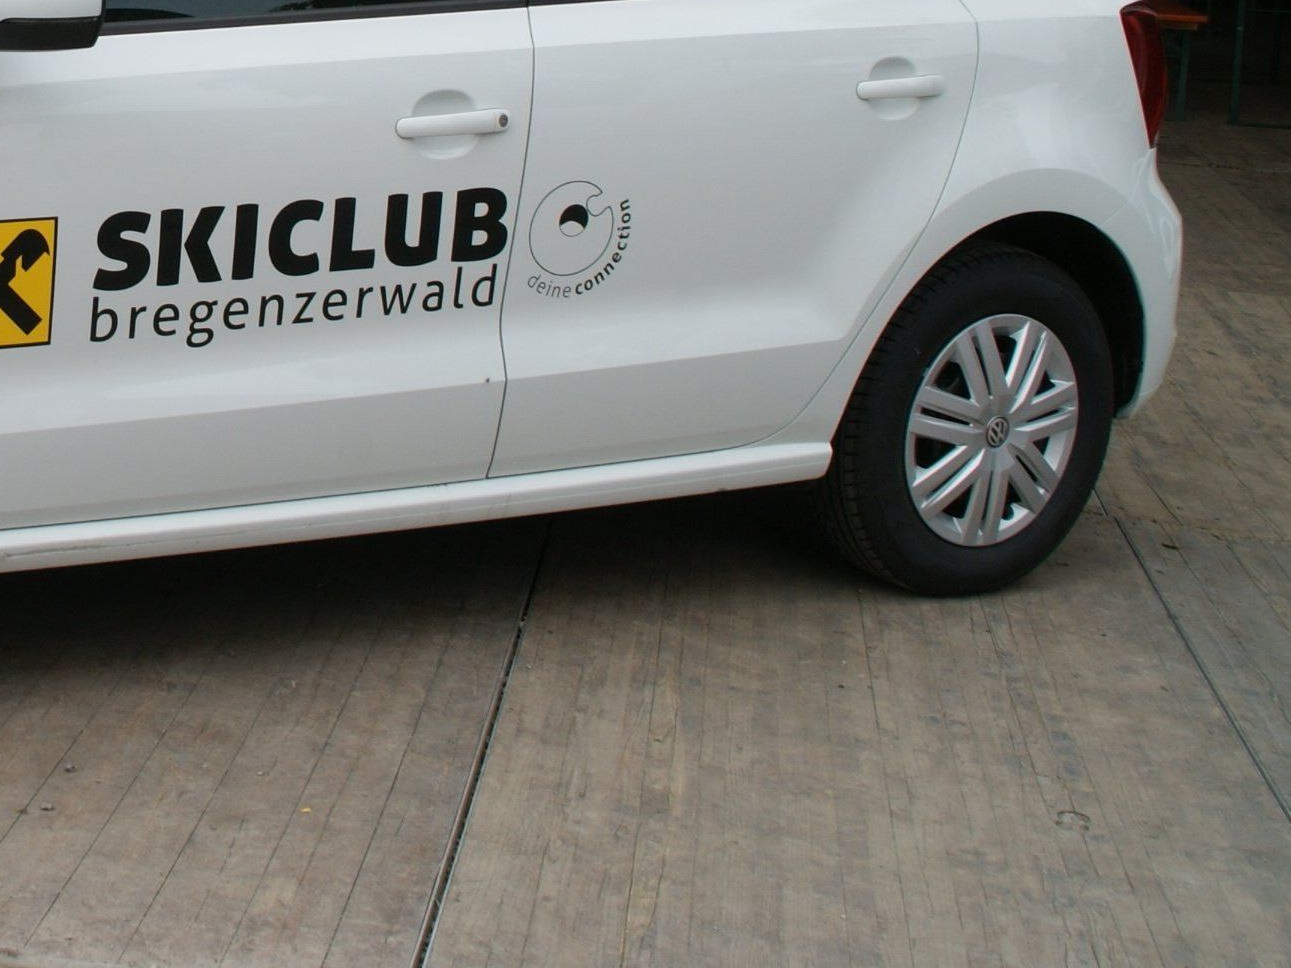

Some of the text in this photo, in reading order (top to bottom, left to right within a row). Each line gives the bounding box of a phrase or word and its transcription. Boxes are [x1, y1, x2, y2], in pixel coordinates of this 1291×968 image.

[93, 186, 508, 292] SKICLUB
[527, 198, 632, 299] deine connection
[90, 263, 498, 349] bregenzerwald
